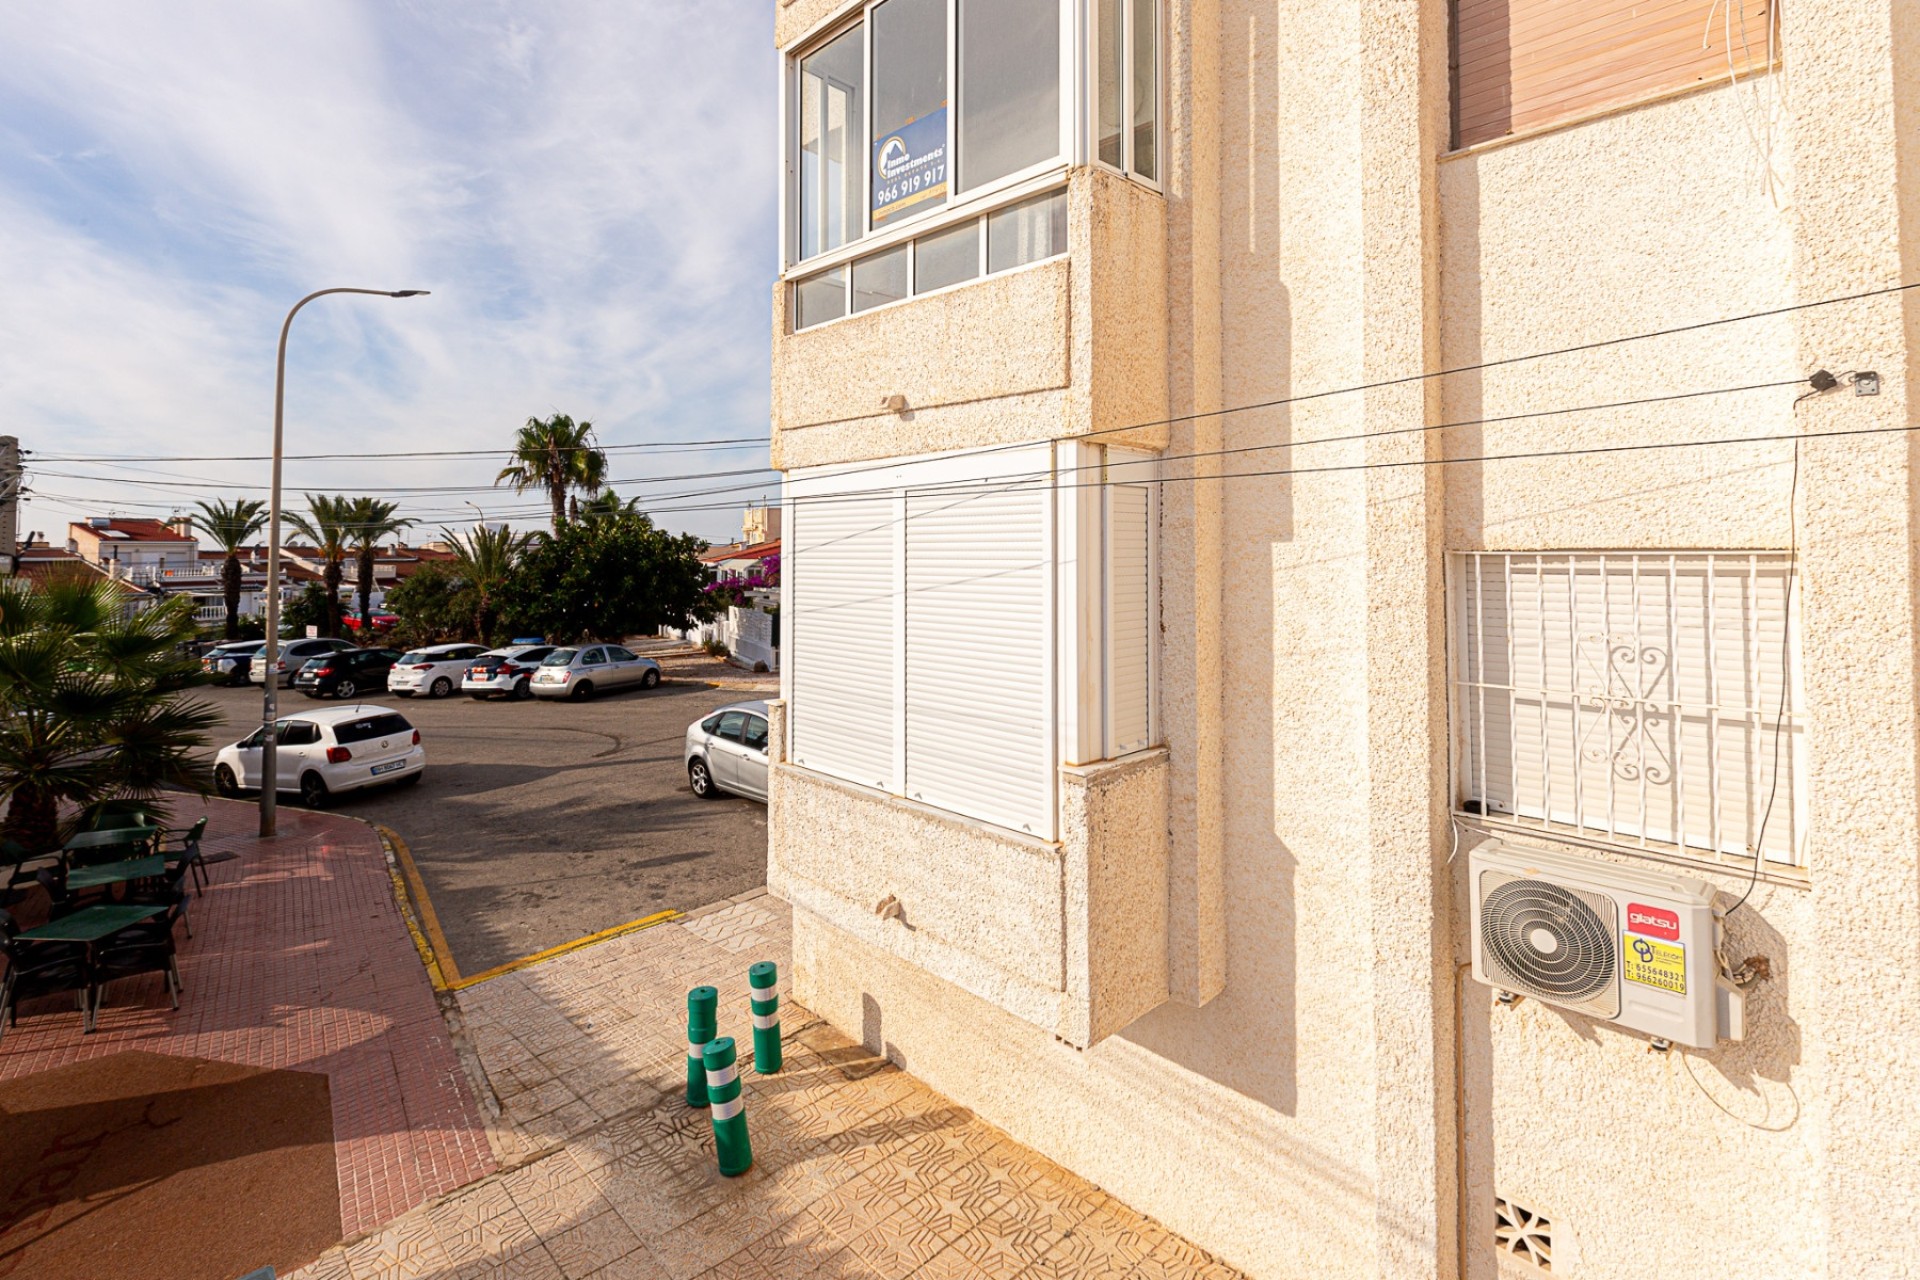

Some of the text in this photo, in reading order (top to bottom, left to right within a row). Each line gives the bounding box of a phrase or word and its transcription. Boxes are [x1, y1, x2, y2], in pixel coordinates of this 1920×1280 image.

[887, 153, 910, 169] Inmo
[887, 147, 944, 179] Investments
[878, 184, 898, 206] 966
[901, 175, 920, 196] 919
[924, 164, 945, 187] 917
[1630, 912, 1677, 930] giatsu
[1626, 960, 1684, 982] T: 655648321
[1626, 969, 1685, 991] T: 966260019
